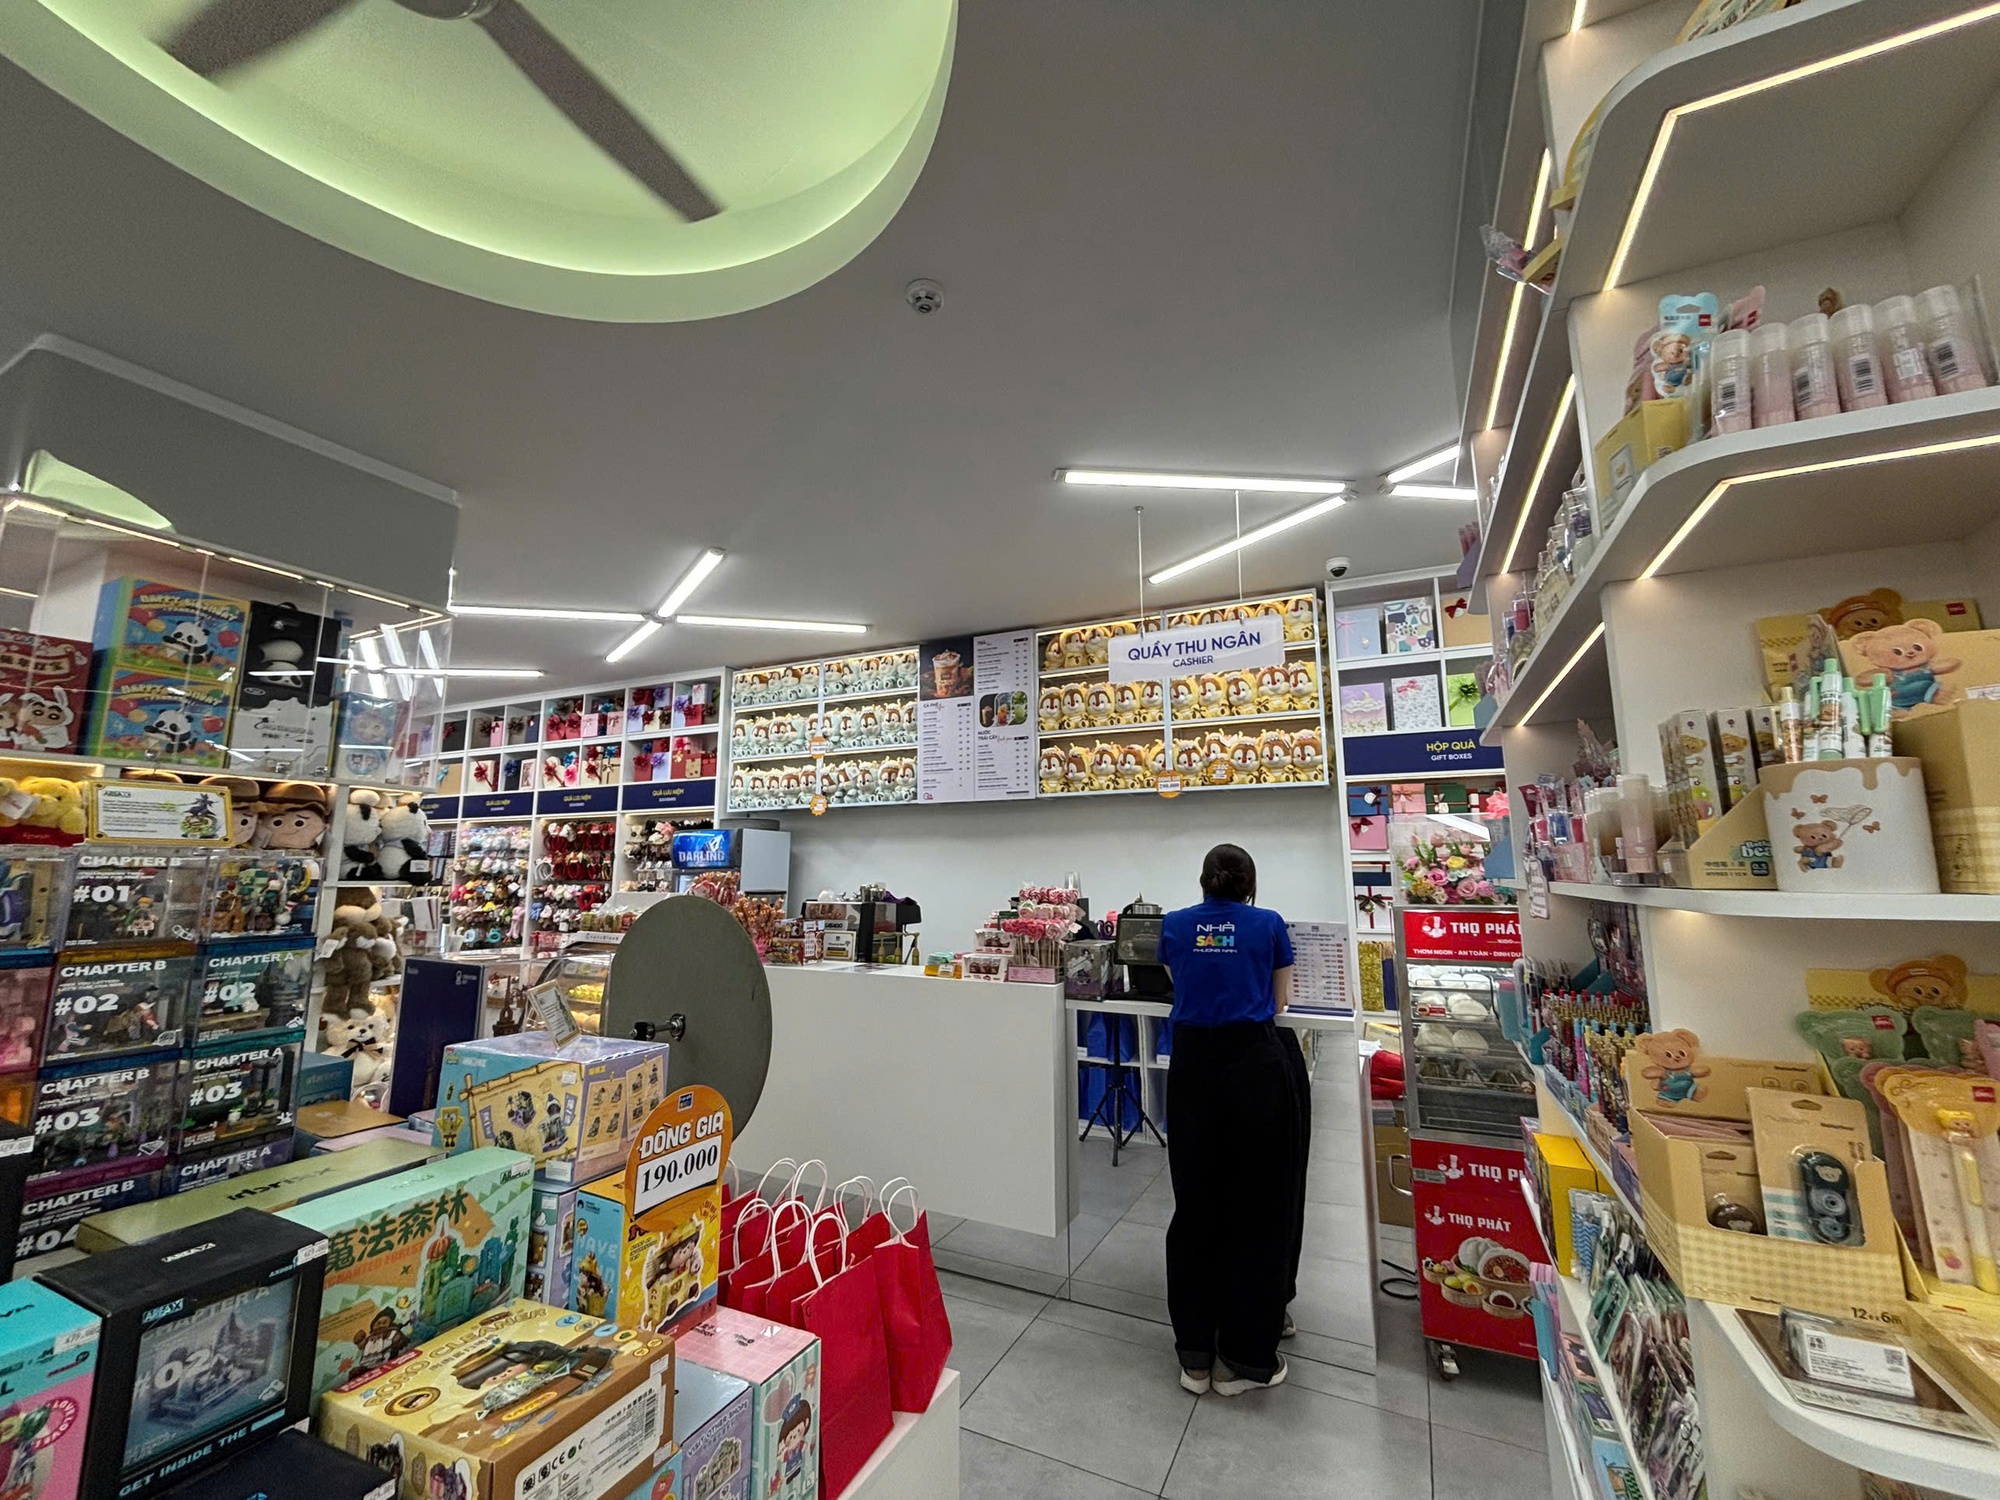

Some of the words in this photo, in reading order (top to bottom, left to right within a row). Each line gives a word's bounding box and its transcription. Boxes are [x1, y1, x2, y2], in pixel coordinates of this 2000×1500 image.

[1176, 639, 1207, 655] THU
[1212, 631, 1261, 651] NGÂN
[1172, 656, 1214, 668] CASHIER
[1426, 741, 1449, 753] HỘP
[79, 856, 167, 867] CHAPTER
[170, 857, 182, 867] B
[678, 851, 725, 862] DARLING
[73, 883, 130, 904] #01
[1196, 921, 1235, 932] NHÀ
[1450, 922, 1480, 937] THỌ
[1196, 933, 1235, 947] SÁCH
[60, 961, 151, 978] CHAPTER
[153, 959, 167, 971] B
[206, 953, 277, 972] CHAPTER
[278, 951, 294, 962] A
[203, 982, 256, 1004] #02
[54, 993, 119, 1016] #02
[195, 1050, 271, 1070] CHAPTER
[273, 1047, 284, 1058] A
[41, 1071, 136, 1094] CHAPTER
[137, 1069, 150, 1081] B
[190, 1081, 243, 1106] #03
[35, 1107, 100, 1135] #03
[637, 1122, 693, 1160] ĐỒNG
[180, 1149, 258, 1177] CHAPTER
[259, 1146, 272, 1158] A
[641, 1144, 718, 1195] 190.000
[1468, 1163, 1502, 1183] THỌ
[22, 1184, 121, 1216] CHAPTER
[122, 1180, 135, 1193] B
[1448, 1212, 1473, 1228] THỌ
[1477, 1217, 1512, 1232] PHÁT
[119, 1472, 155, 1498] GET
[159, 1444, 212, 1478] INSIDE
[218, 1426, 248, 1448] THE
